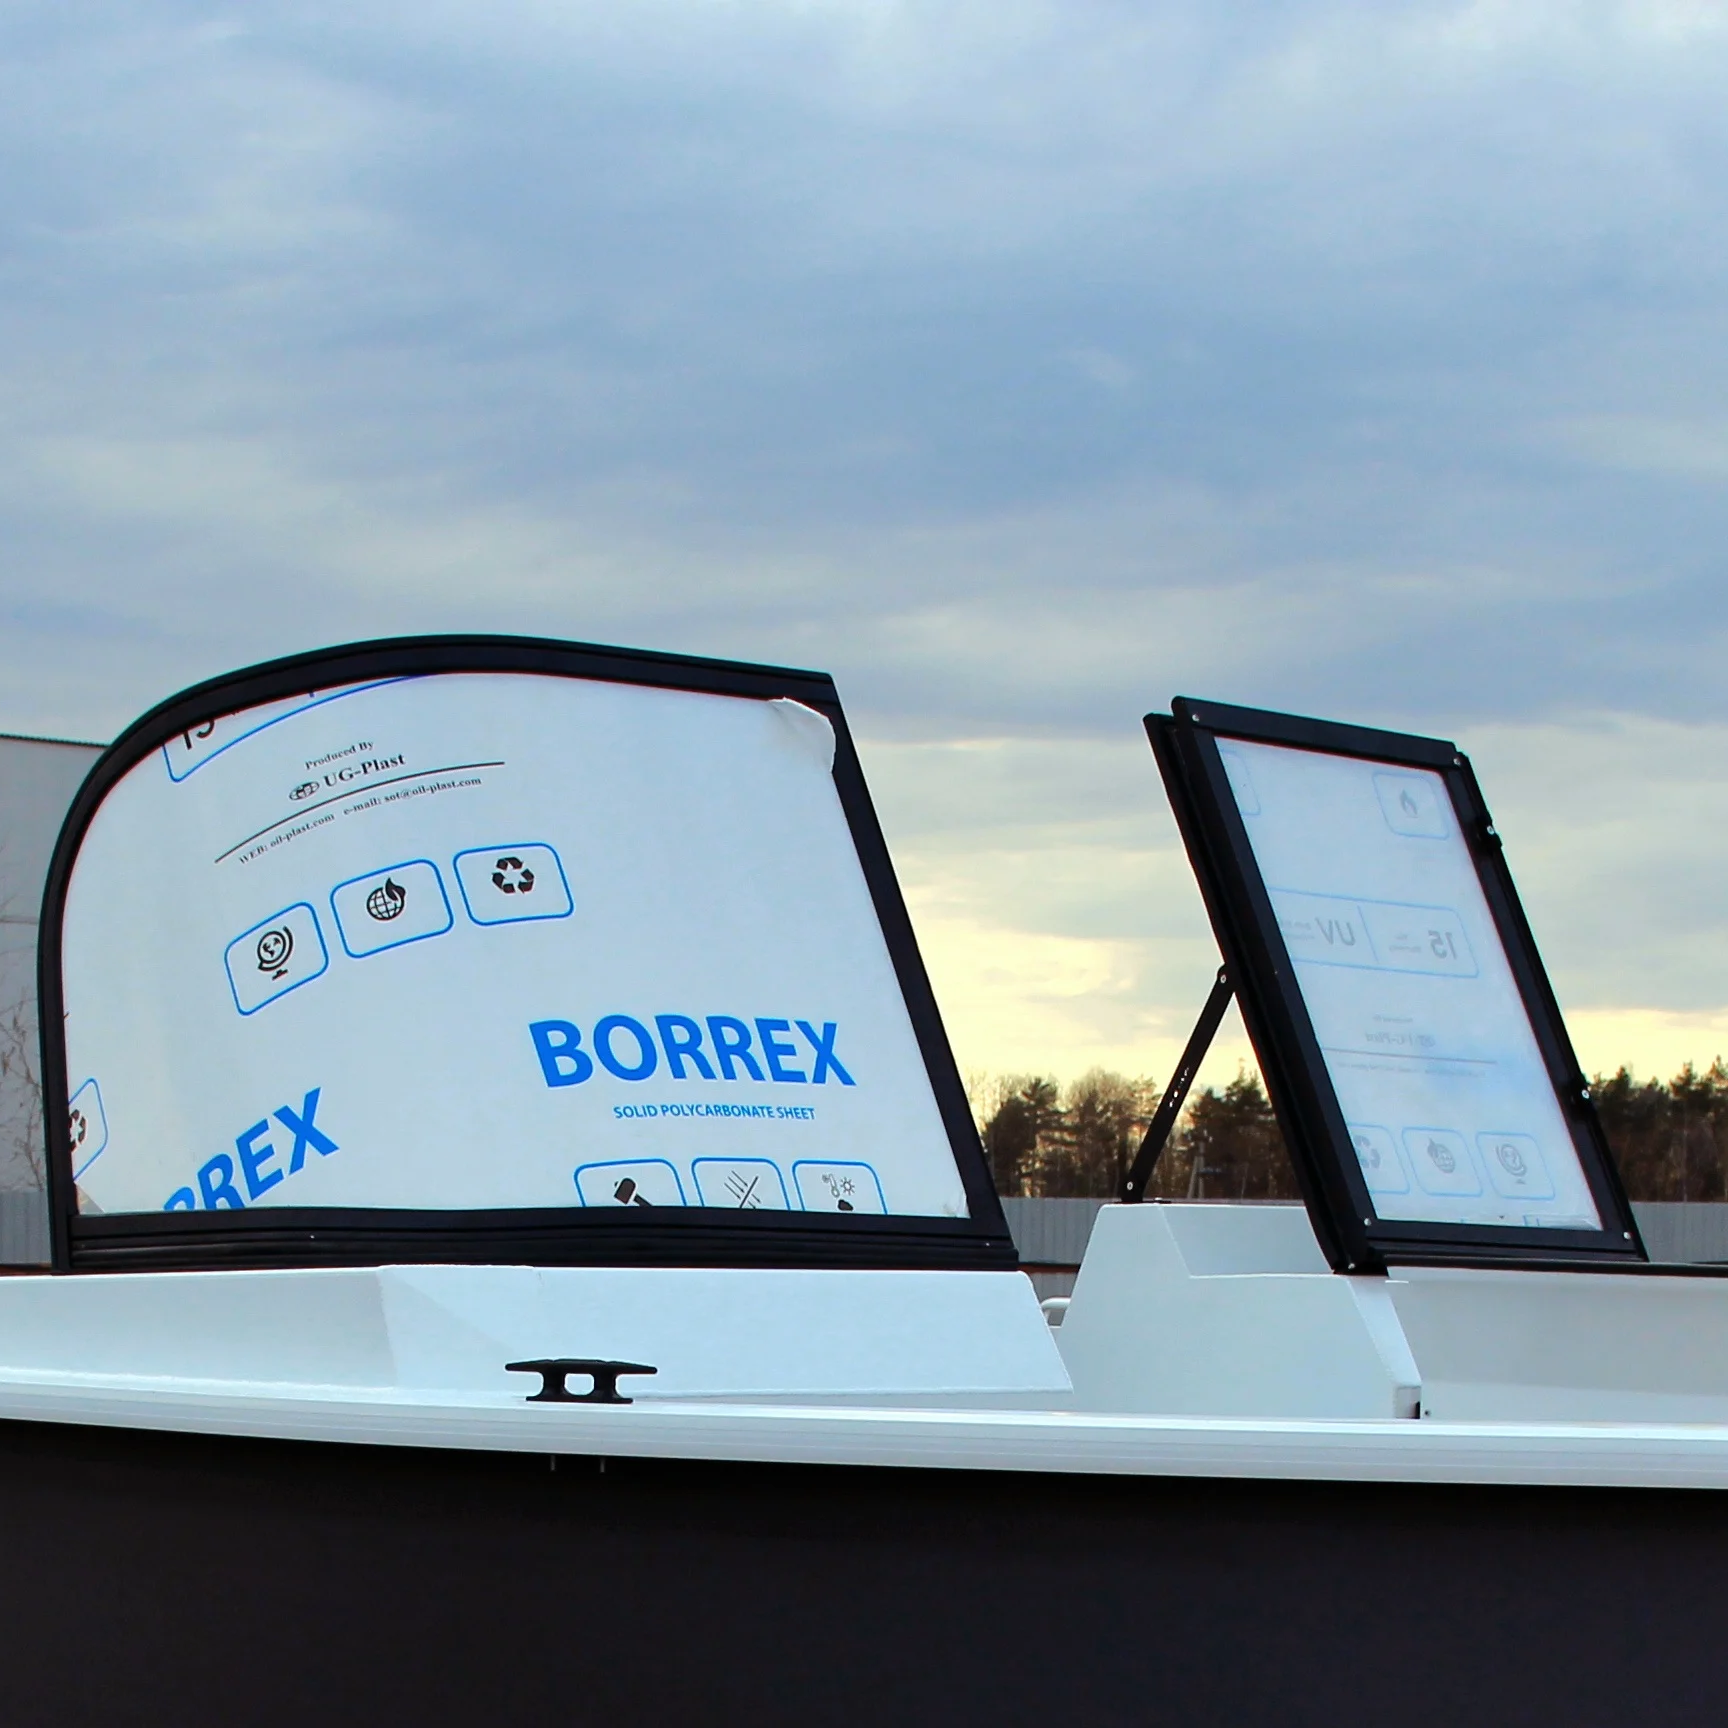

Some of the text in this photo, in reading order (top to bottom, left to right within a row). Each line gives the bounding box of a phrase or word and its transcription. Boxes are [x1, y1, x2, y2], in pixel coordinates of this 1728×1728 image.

[305, 741, 374, 770] Produced By
[323, 753, 406, 788] UG-Plast
[529, 1014, 856, 1088] BORREX
[613, 1104, 816, 1120] SOLID POLYCARBONATE SHEET
